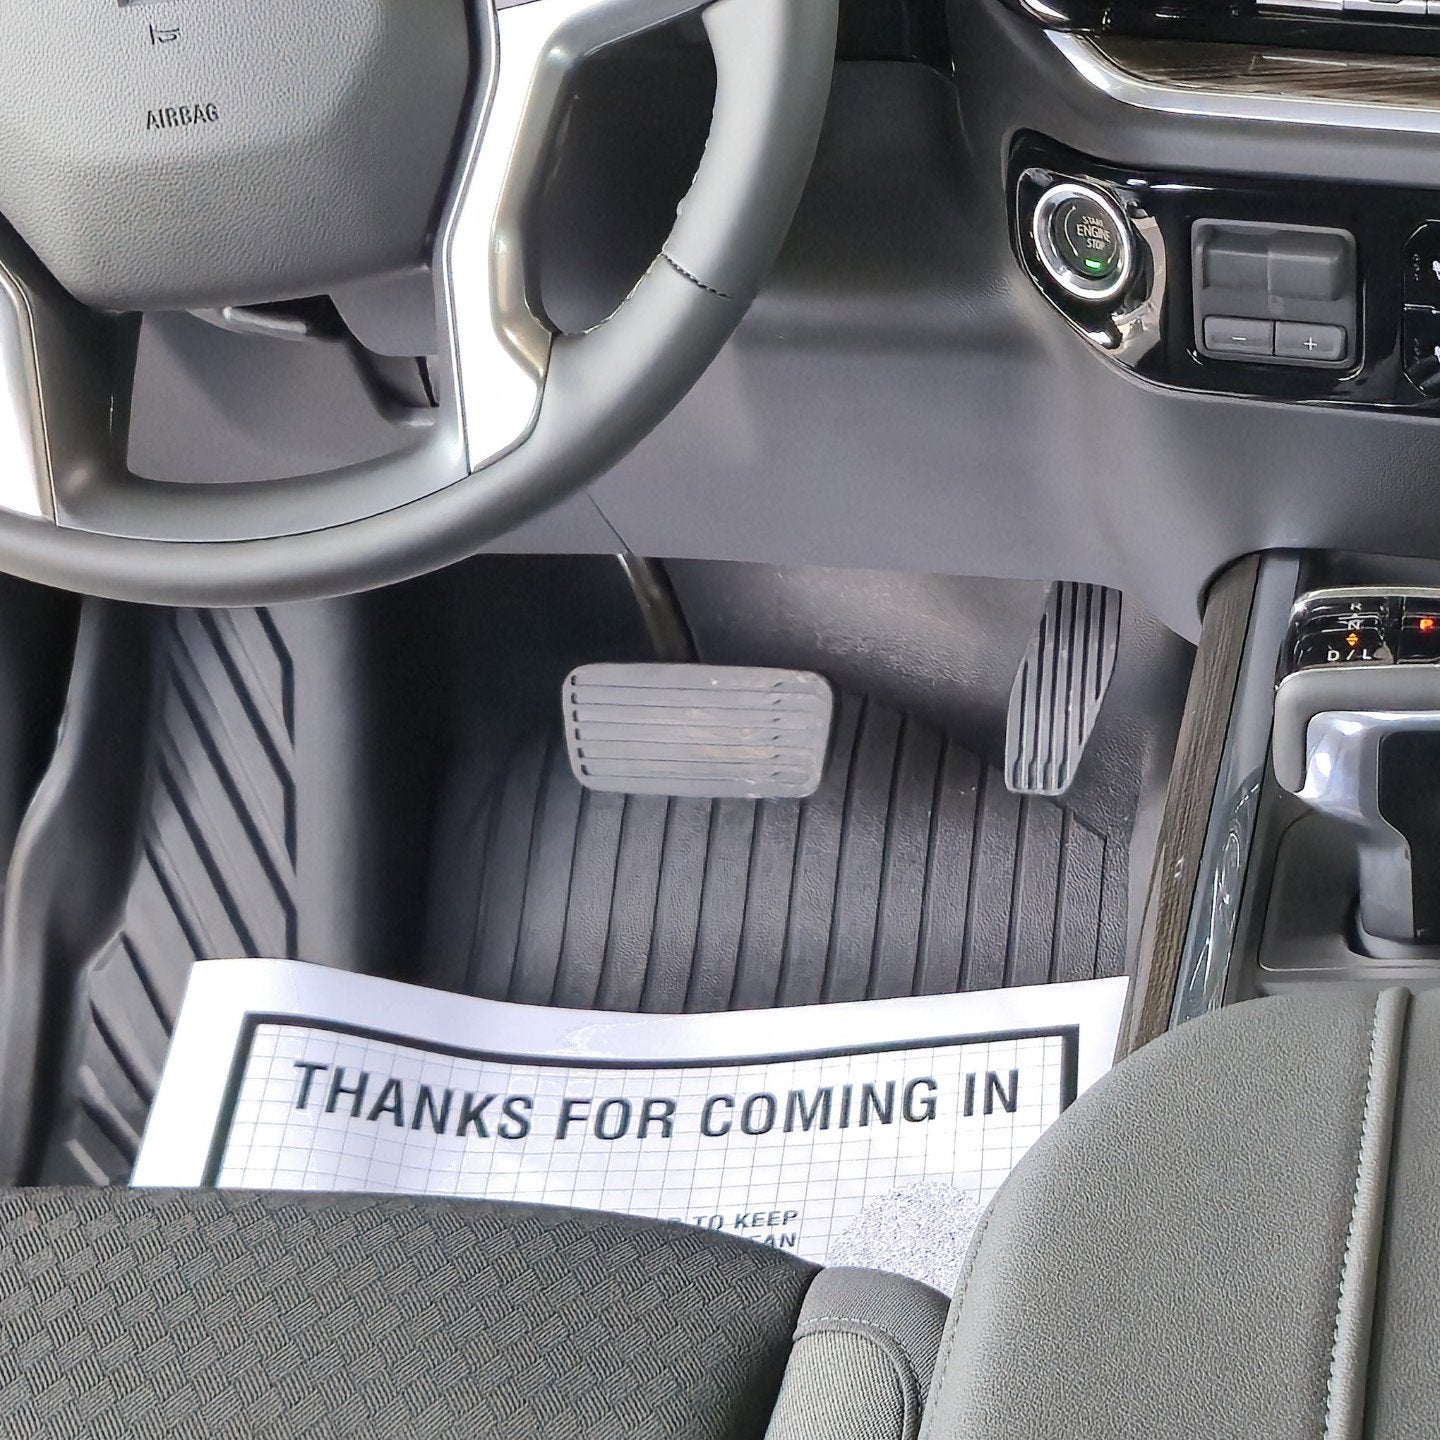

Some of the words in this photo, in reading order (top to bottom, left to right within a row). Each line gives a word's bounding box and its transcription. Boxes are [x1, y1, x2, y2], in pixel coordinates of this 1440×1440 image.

[147, 103, 219, 130] AIRBAG
[1076, 224, 1110, 243] ENGINE
[1086, 238, 1106, 250] STOP
[1419, 618, 1434, 630] P
[1327, 650, 1340, 661] D
[1362, 649, 1372, 660] L
[294, 1060, 534, 1140] THANKS
[554, 1094, 678, 1141] FOR
[700, 1076, 938, 1138] COMING
[963, 1068, 1019, 1118] IN
[693, 1214, 724, 1230] TO
[734, 1210, 798, 1229] KEEP
